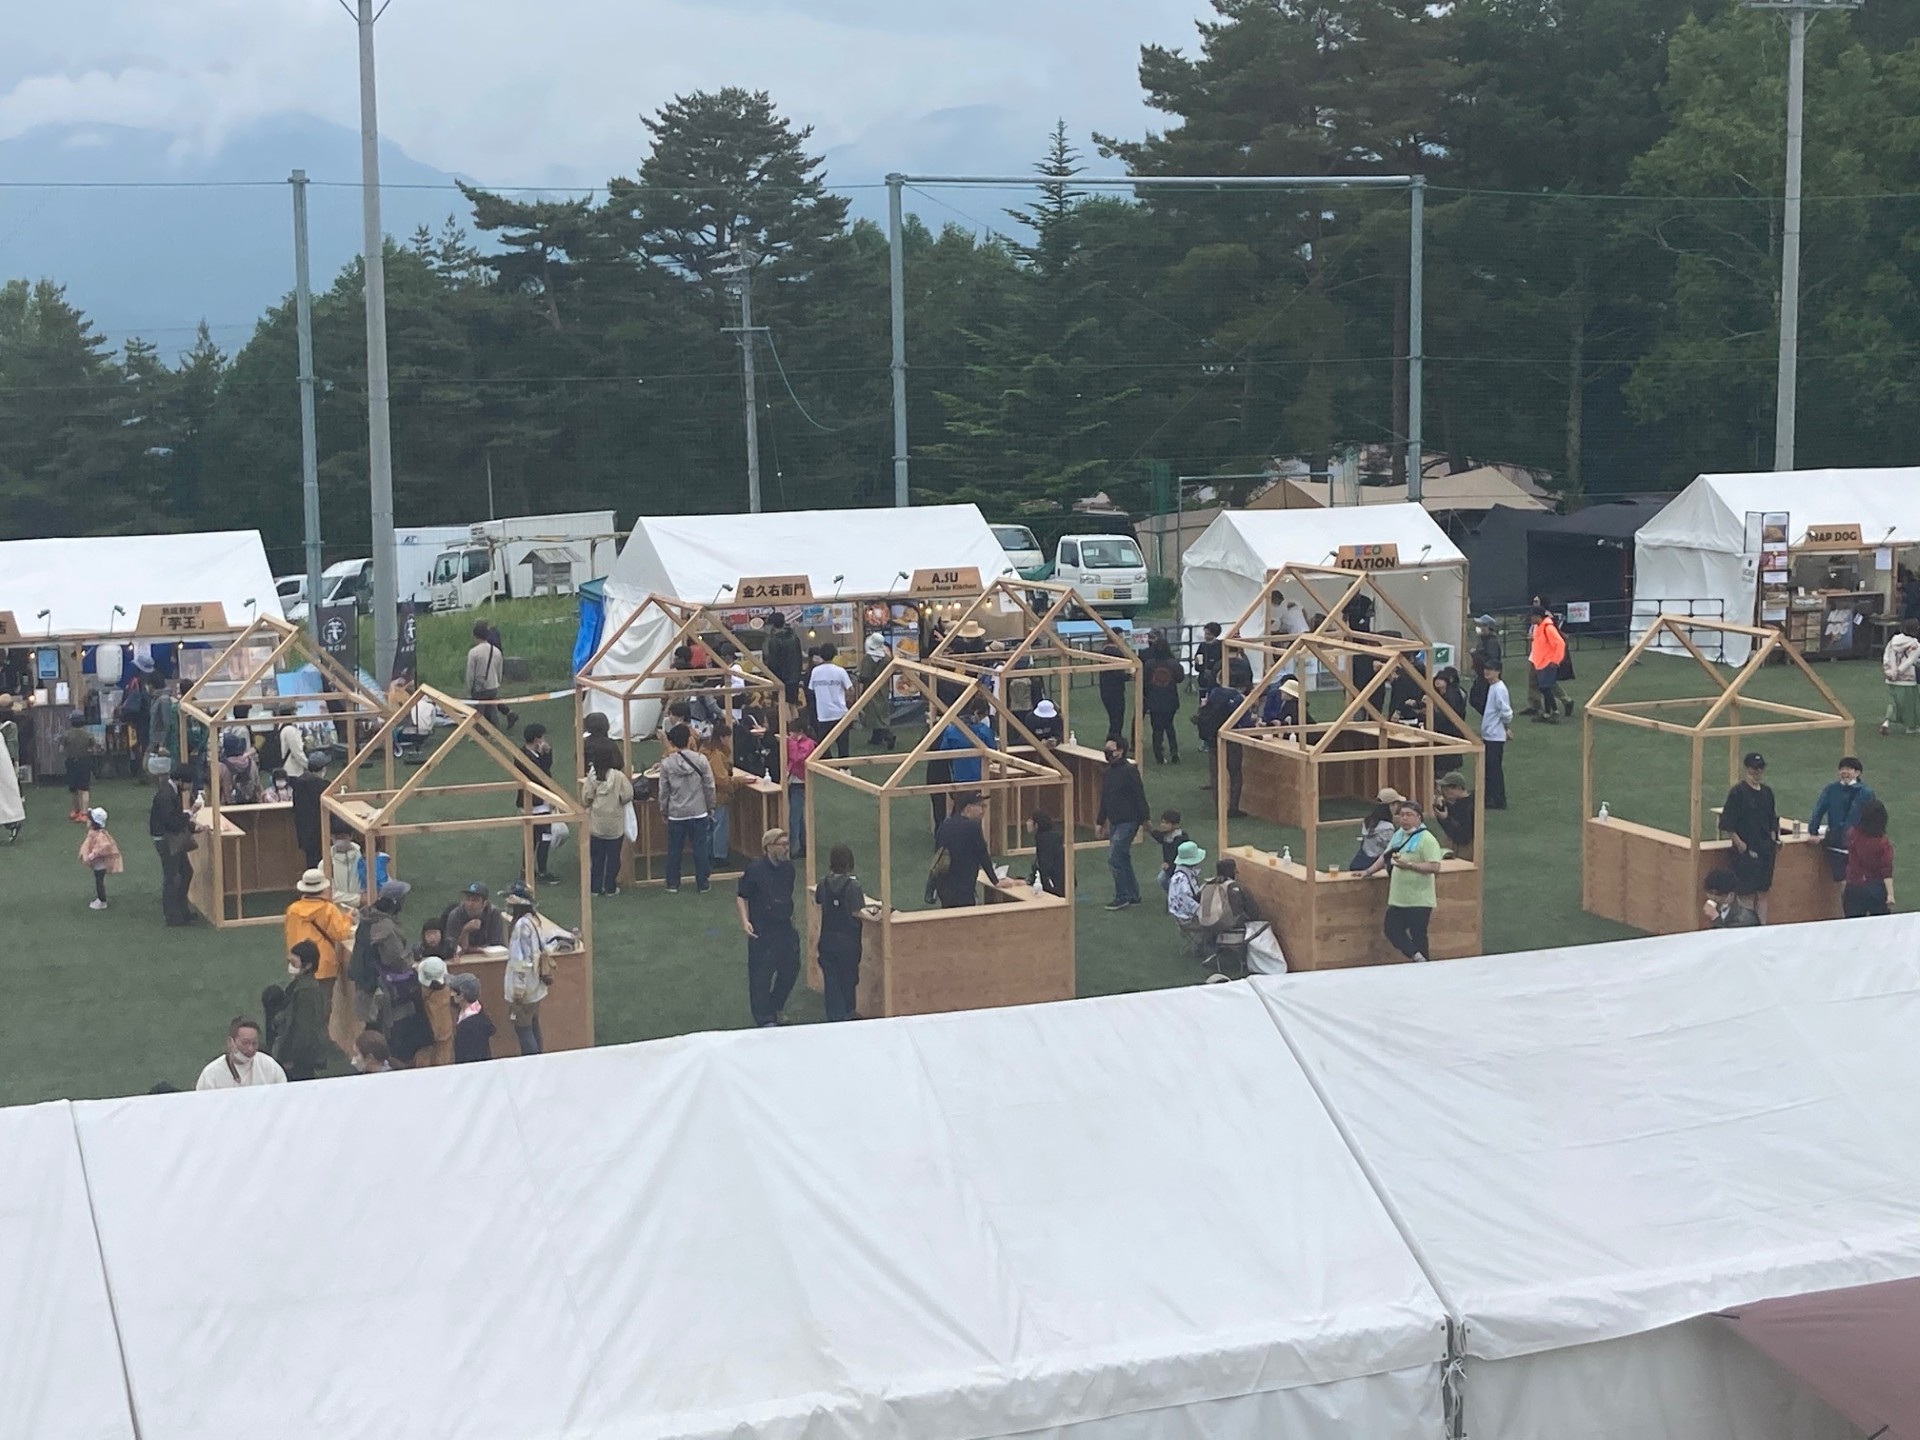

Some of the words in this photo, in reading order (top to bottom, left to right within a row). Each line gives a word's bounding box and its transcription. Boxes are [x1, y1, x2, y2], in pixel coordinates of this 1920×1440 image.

[1835, 531, 1857, 542] DOG
[1341, 557, 1395, 569] STATION
[932, 572, 958, 583] A.SU
[743, 583, 806, 598] 金久右衛門
